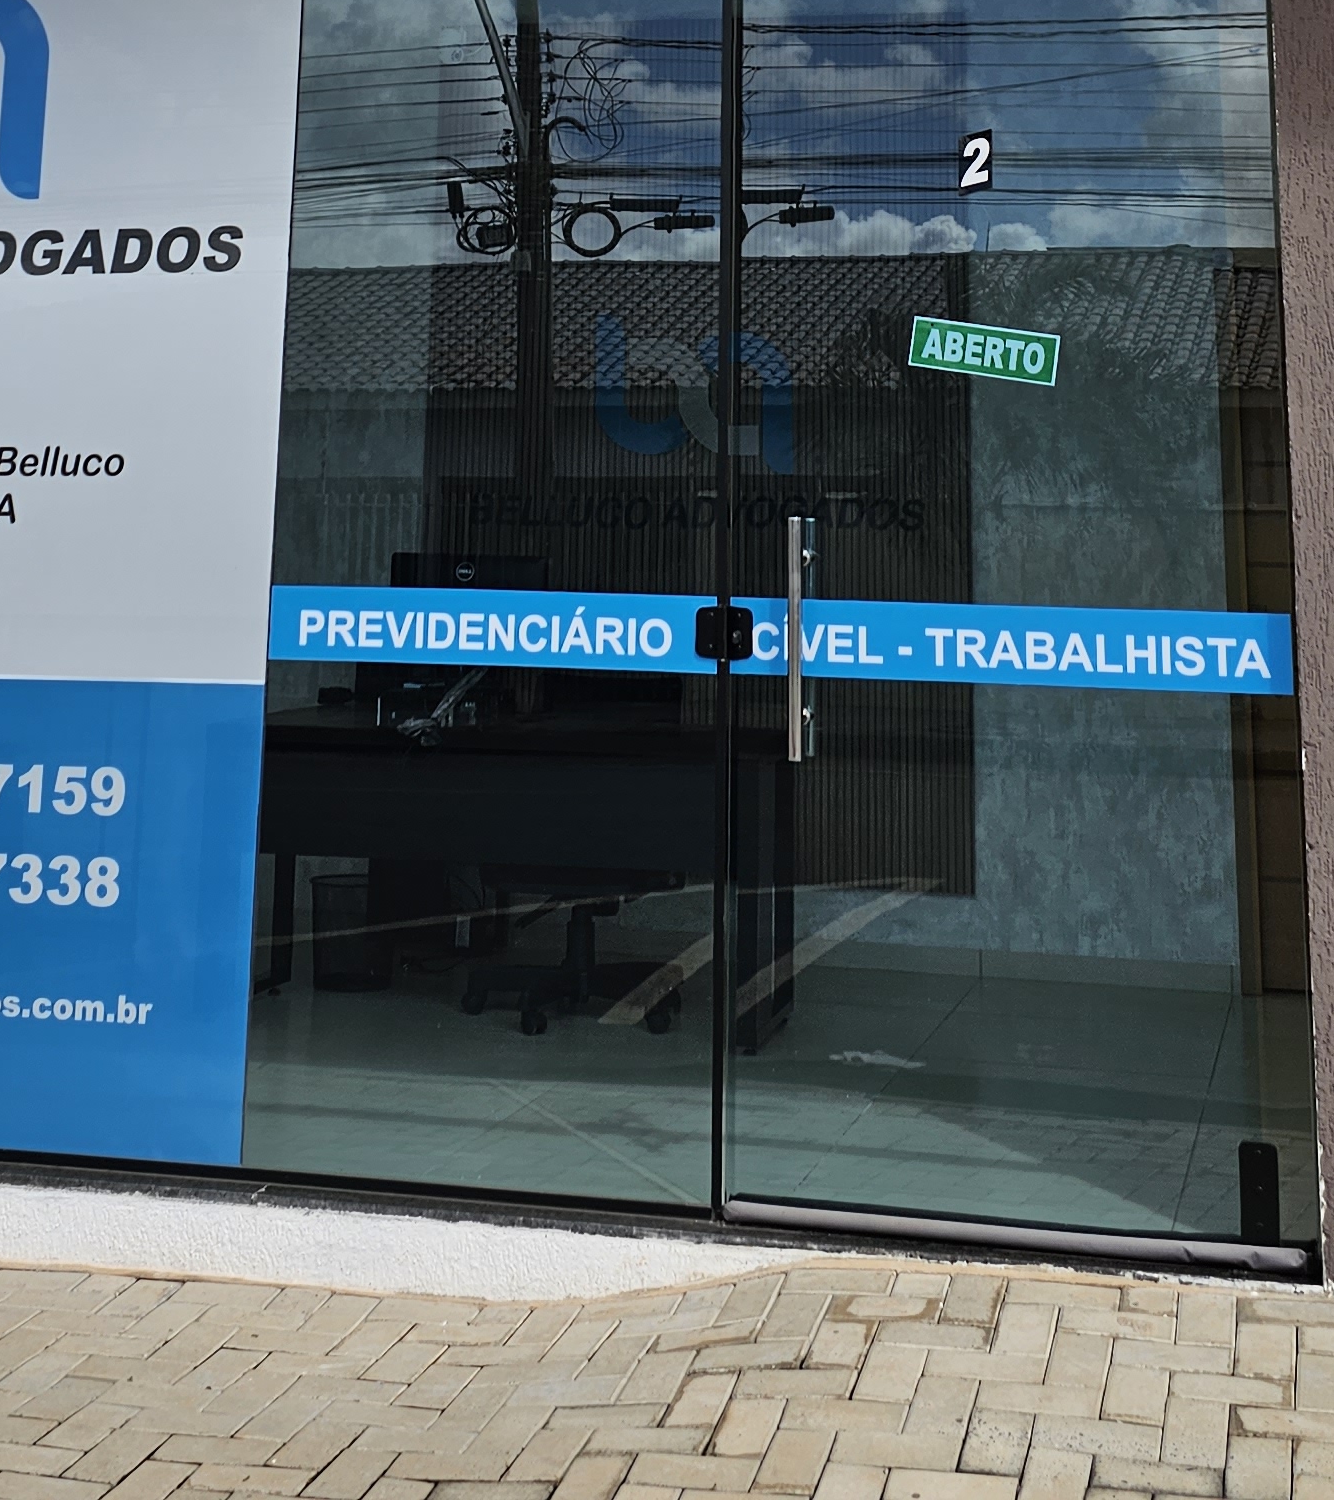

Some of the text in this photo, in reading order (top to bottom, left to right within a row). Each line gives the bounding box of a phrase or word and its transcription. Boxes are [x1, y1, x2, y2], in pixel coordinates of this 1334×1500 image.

[960, 137, 991, 188] 2
[921, 328, 1046, 375] ABERTO
[299, 606, 673, 657] PREVIDENCIÁRIO
[924, 627, 1271, 679] TRABALHISTA
